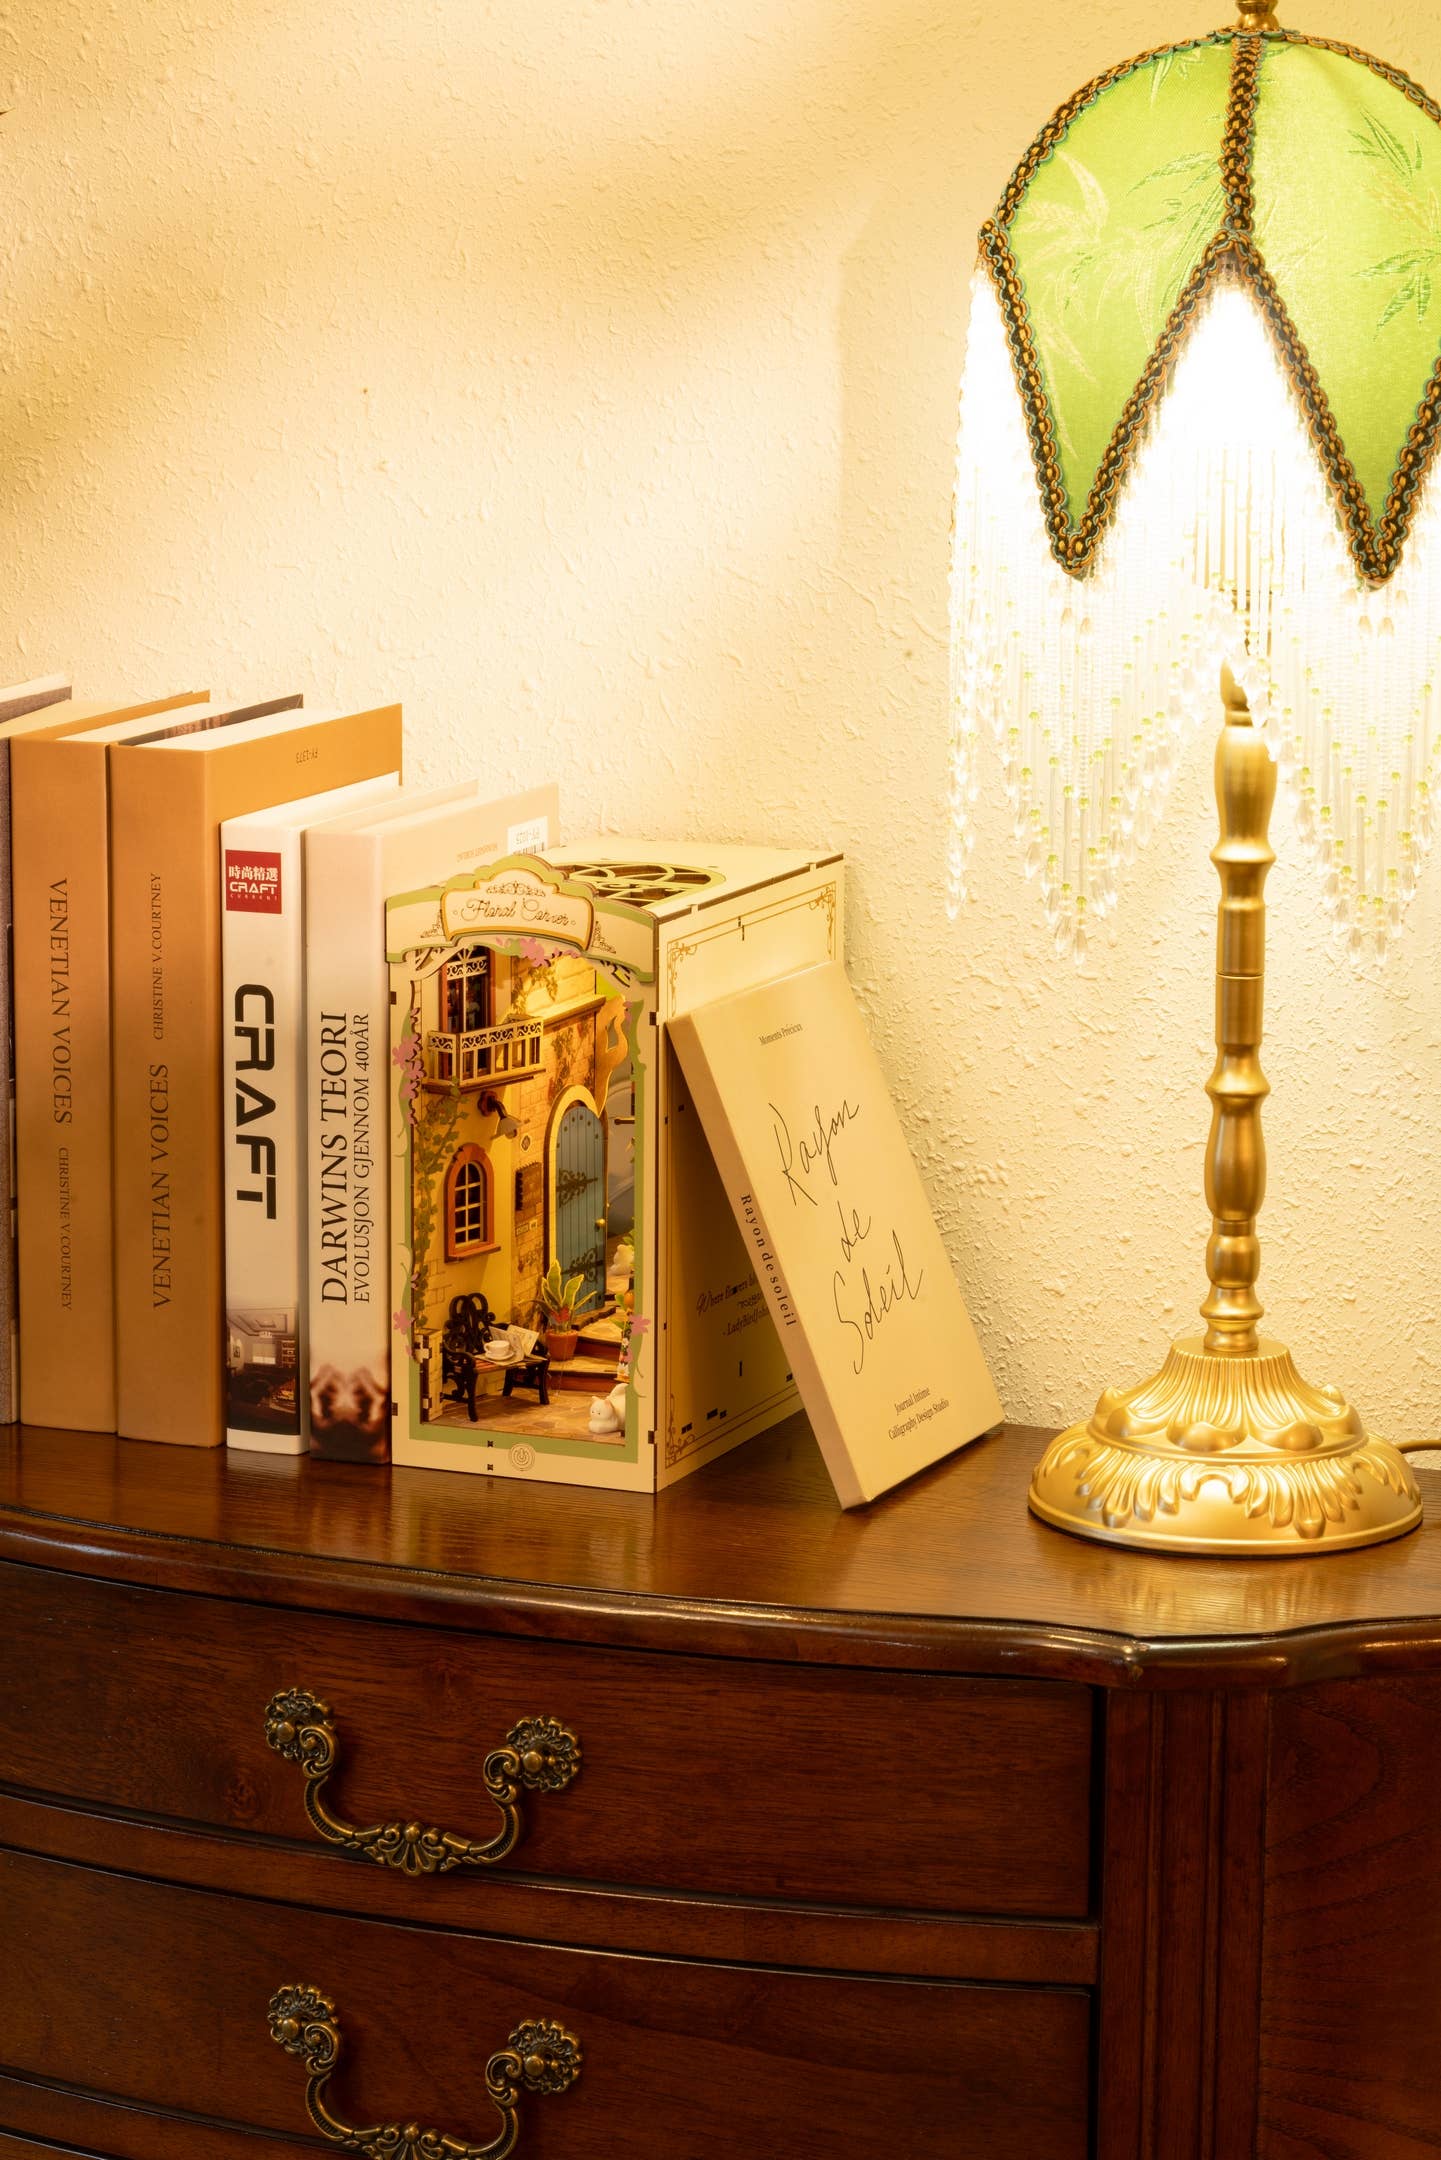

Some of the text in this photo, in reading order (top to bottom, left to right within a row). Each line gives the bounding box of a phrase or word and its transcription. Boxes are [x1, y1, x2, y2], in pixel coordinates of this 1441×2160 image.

[228, 864, 278, 882] 時尚精選
[229, 881, 278, 895] CRAFT
[461, 897, 569, 926] Floral Corner
[49, 878, 73, 1124] VENETIAN VOICES
[152, 967, 164, 1040] CHRISTINE
[234, 983, 277, 1220] CRAFT
[58, 1147, 70, 1220] CHRISTINE
[150, 1063, 171, 1309] VENETIAN VOICES
[320, 1011, 348, 1306] DARWINS TEORI
[350, 1013, 374, 1304] EVOLUSJON GJENNOM 400ÅR
[768, 1099, 860, 1207] Rayon
[740, 1193, 797, 1326] Rayon de soleil
[837, 1199, 871, 1262] de
[833, 1229, 924, 1375] Soleil
[888, 1399, 950, 1440] Calligraphy Design Studio
[894, 1393, 915, 1416] Journal
